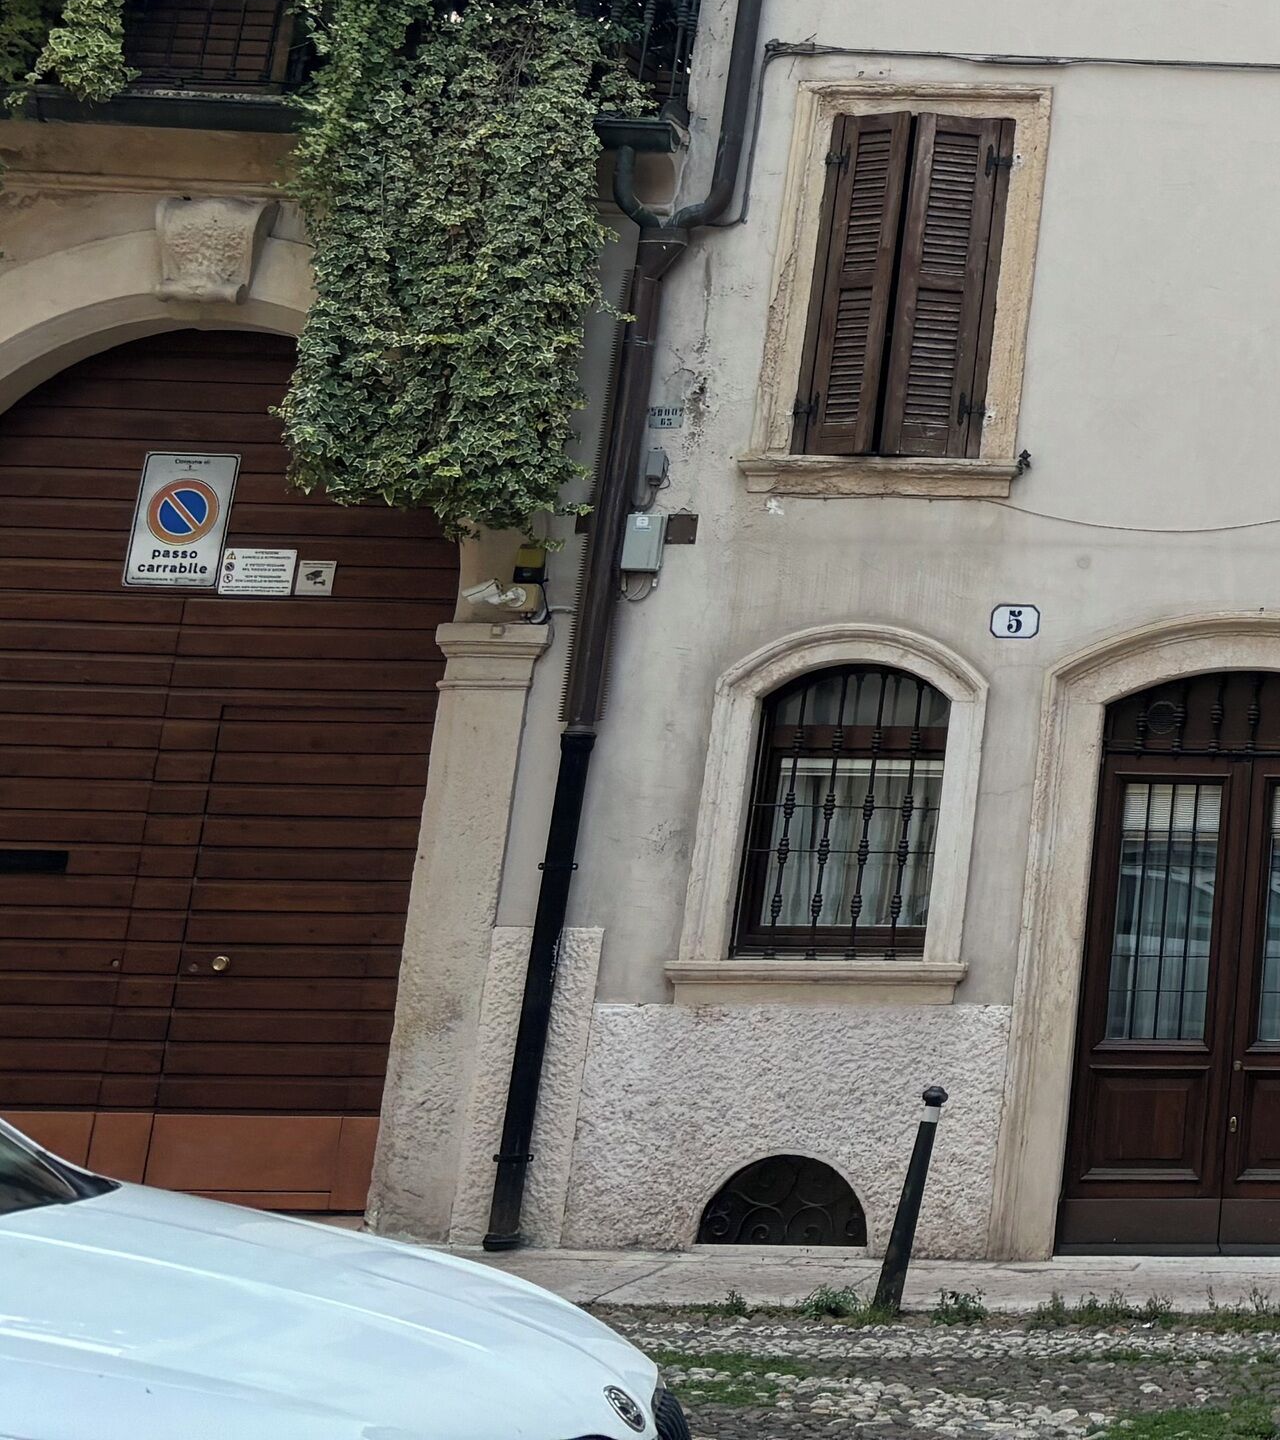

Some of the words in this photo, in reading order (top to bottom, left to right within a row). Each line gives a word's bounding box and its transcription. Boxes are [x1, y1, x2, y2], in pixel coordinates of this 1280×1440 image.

[152, 549, 198, 559] passo
[137, 562, 208, 574] carrabile
[1007, 609, 1022, 633] 5
